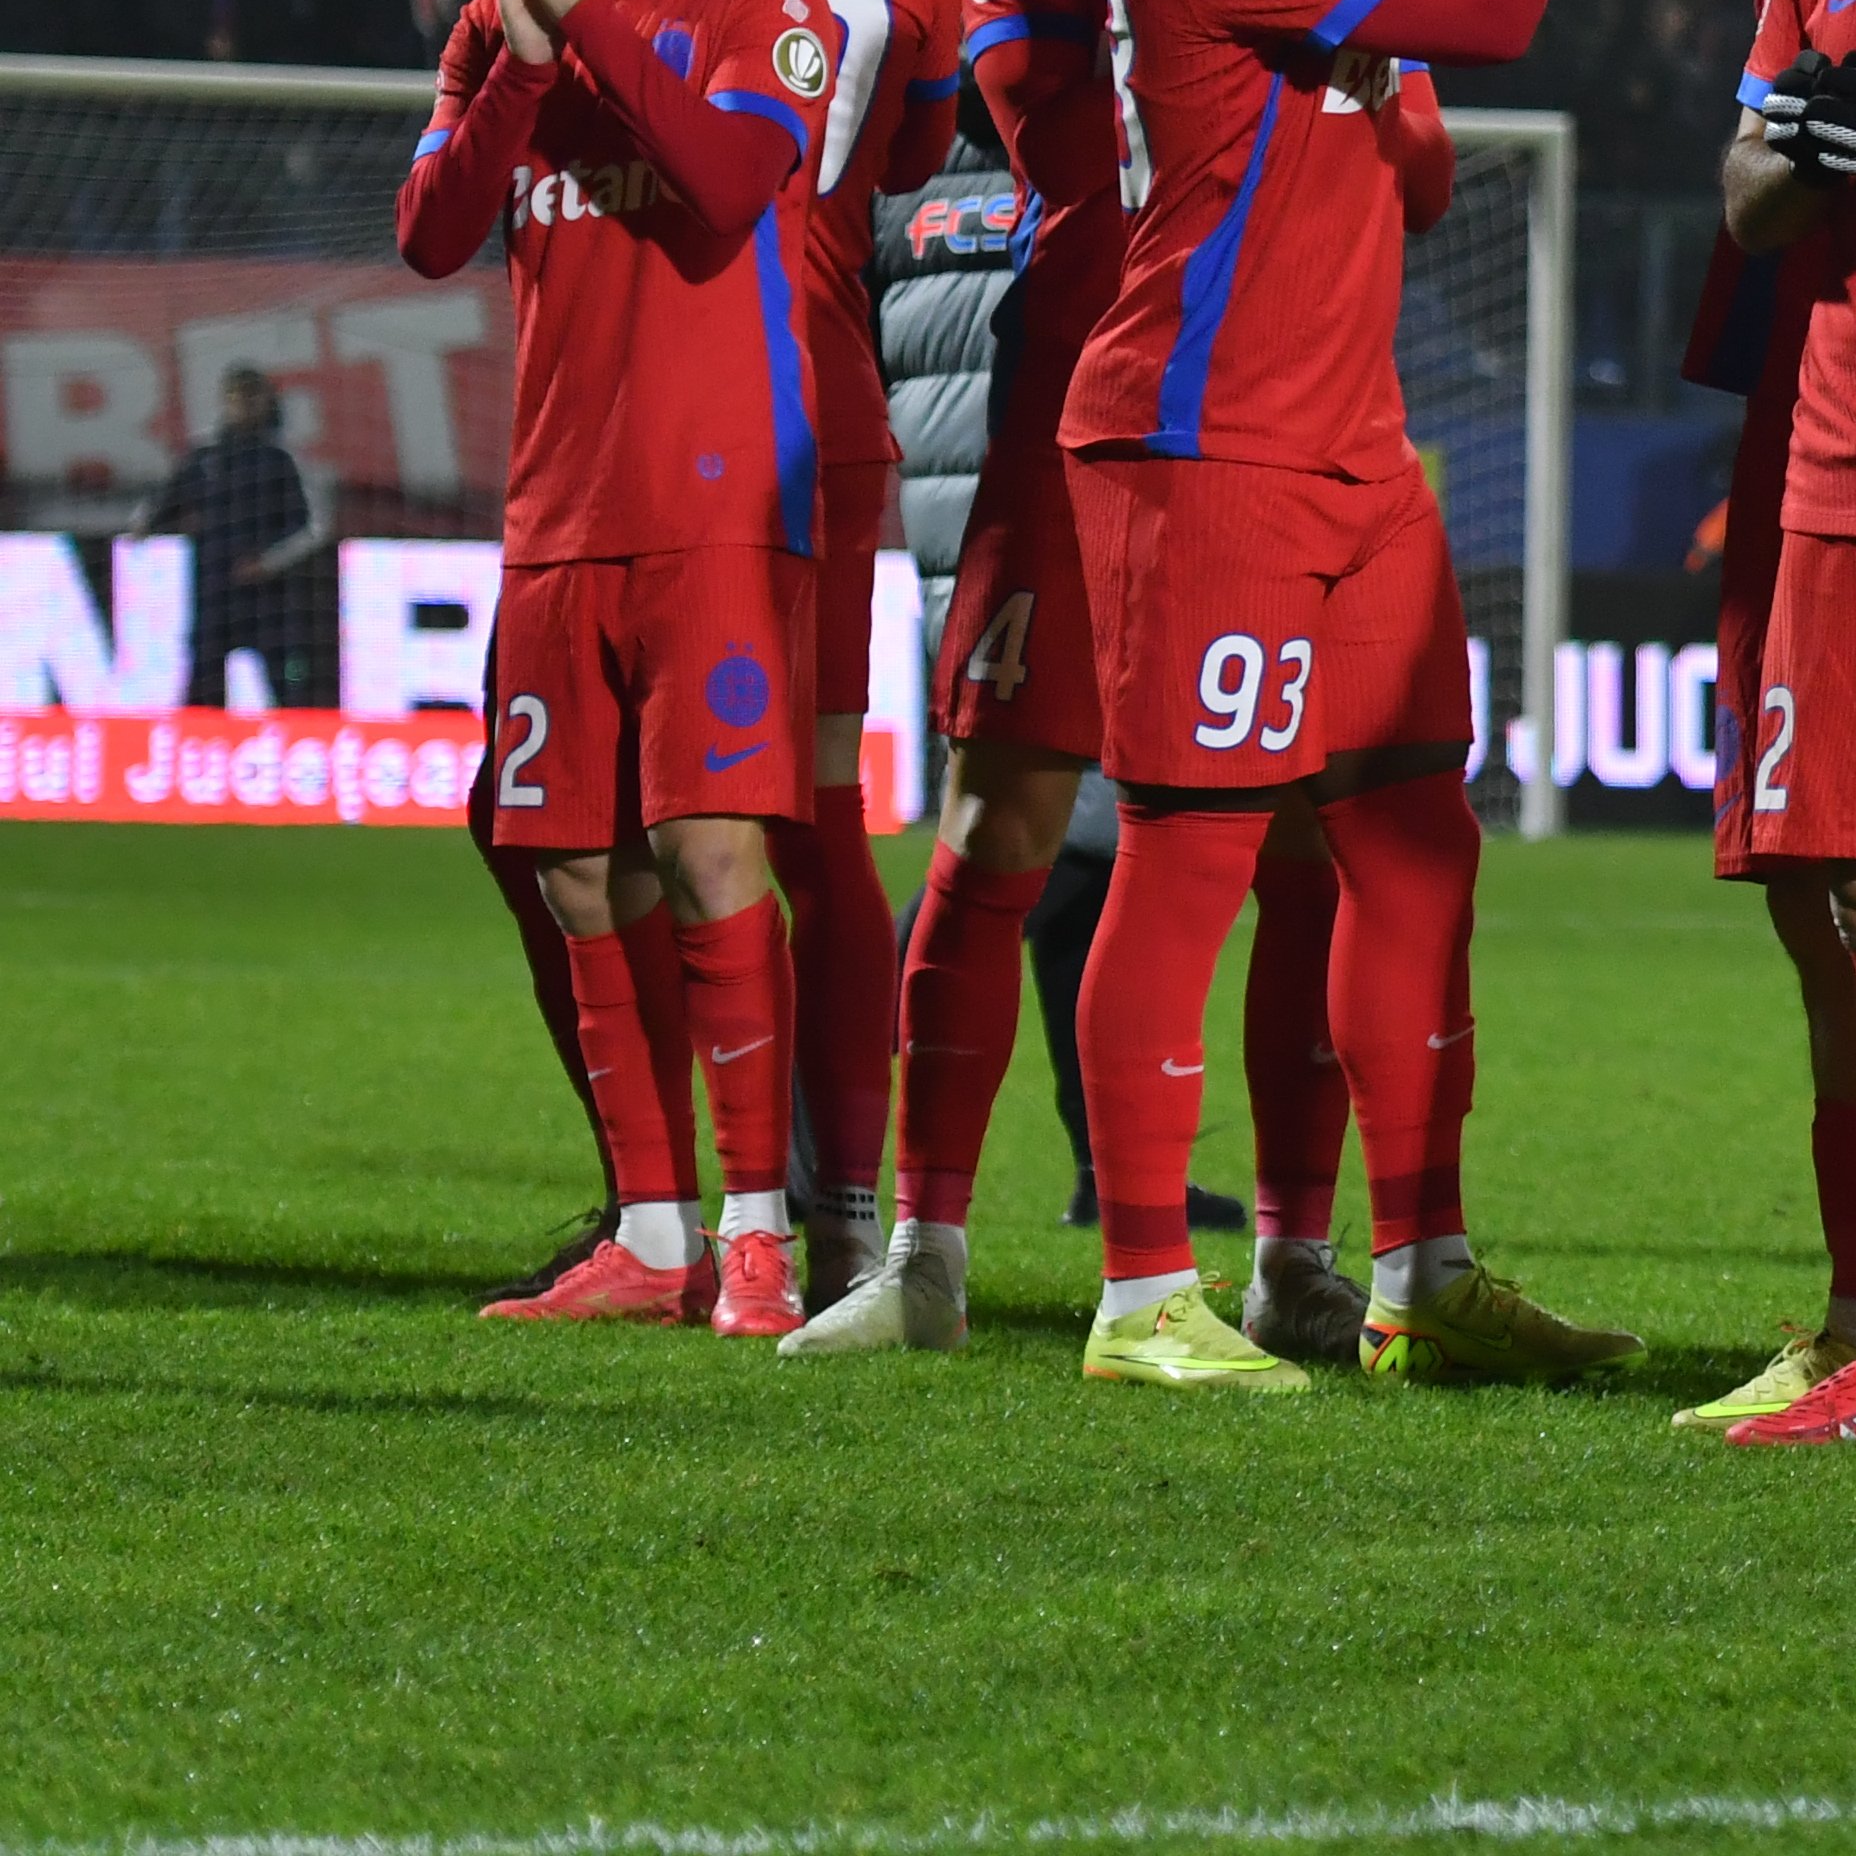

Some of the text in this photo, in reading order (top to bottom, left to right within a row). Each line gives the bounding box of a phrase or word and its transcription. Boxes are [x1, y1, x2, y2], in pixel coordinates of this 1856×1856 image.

[967, 590, 1036, 703] 4
[1194, 632, 1314, 753] 93
[1753, 685, 1794, 812] 2
